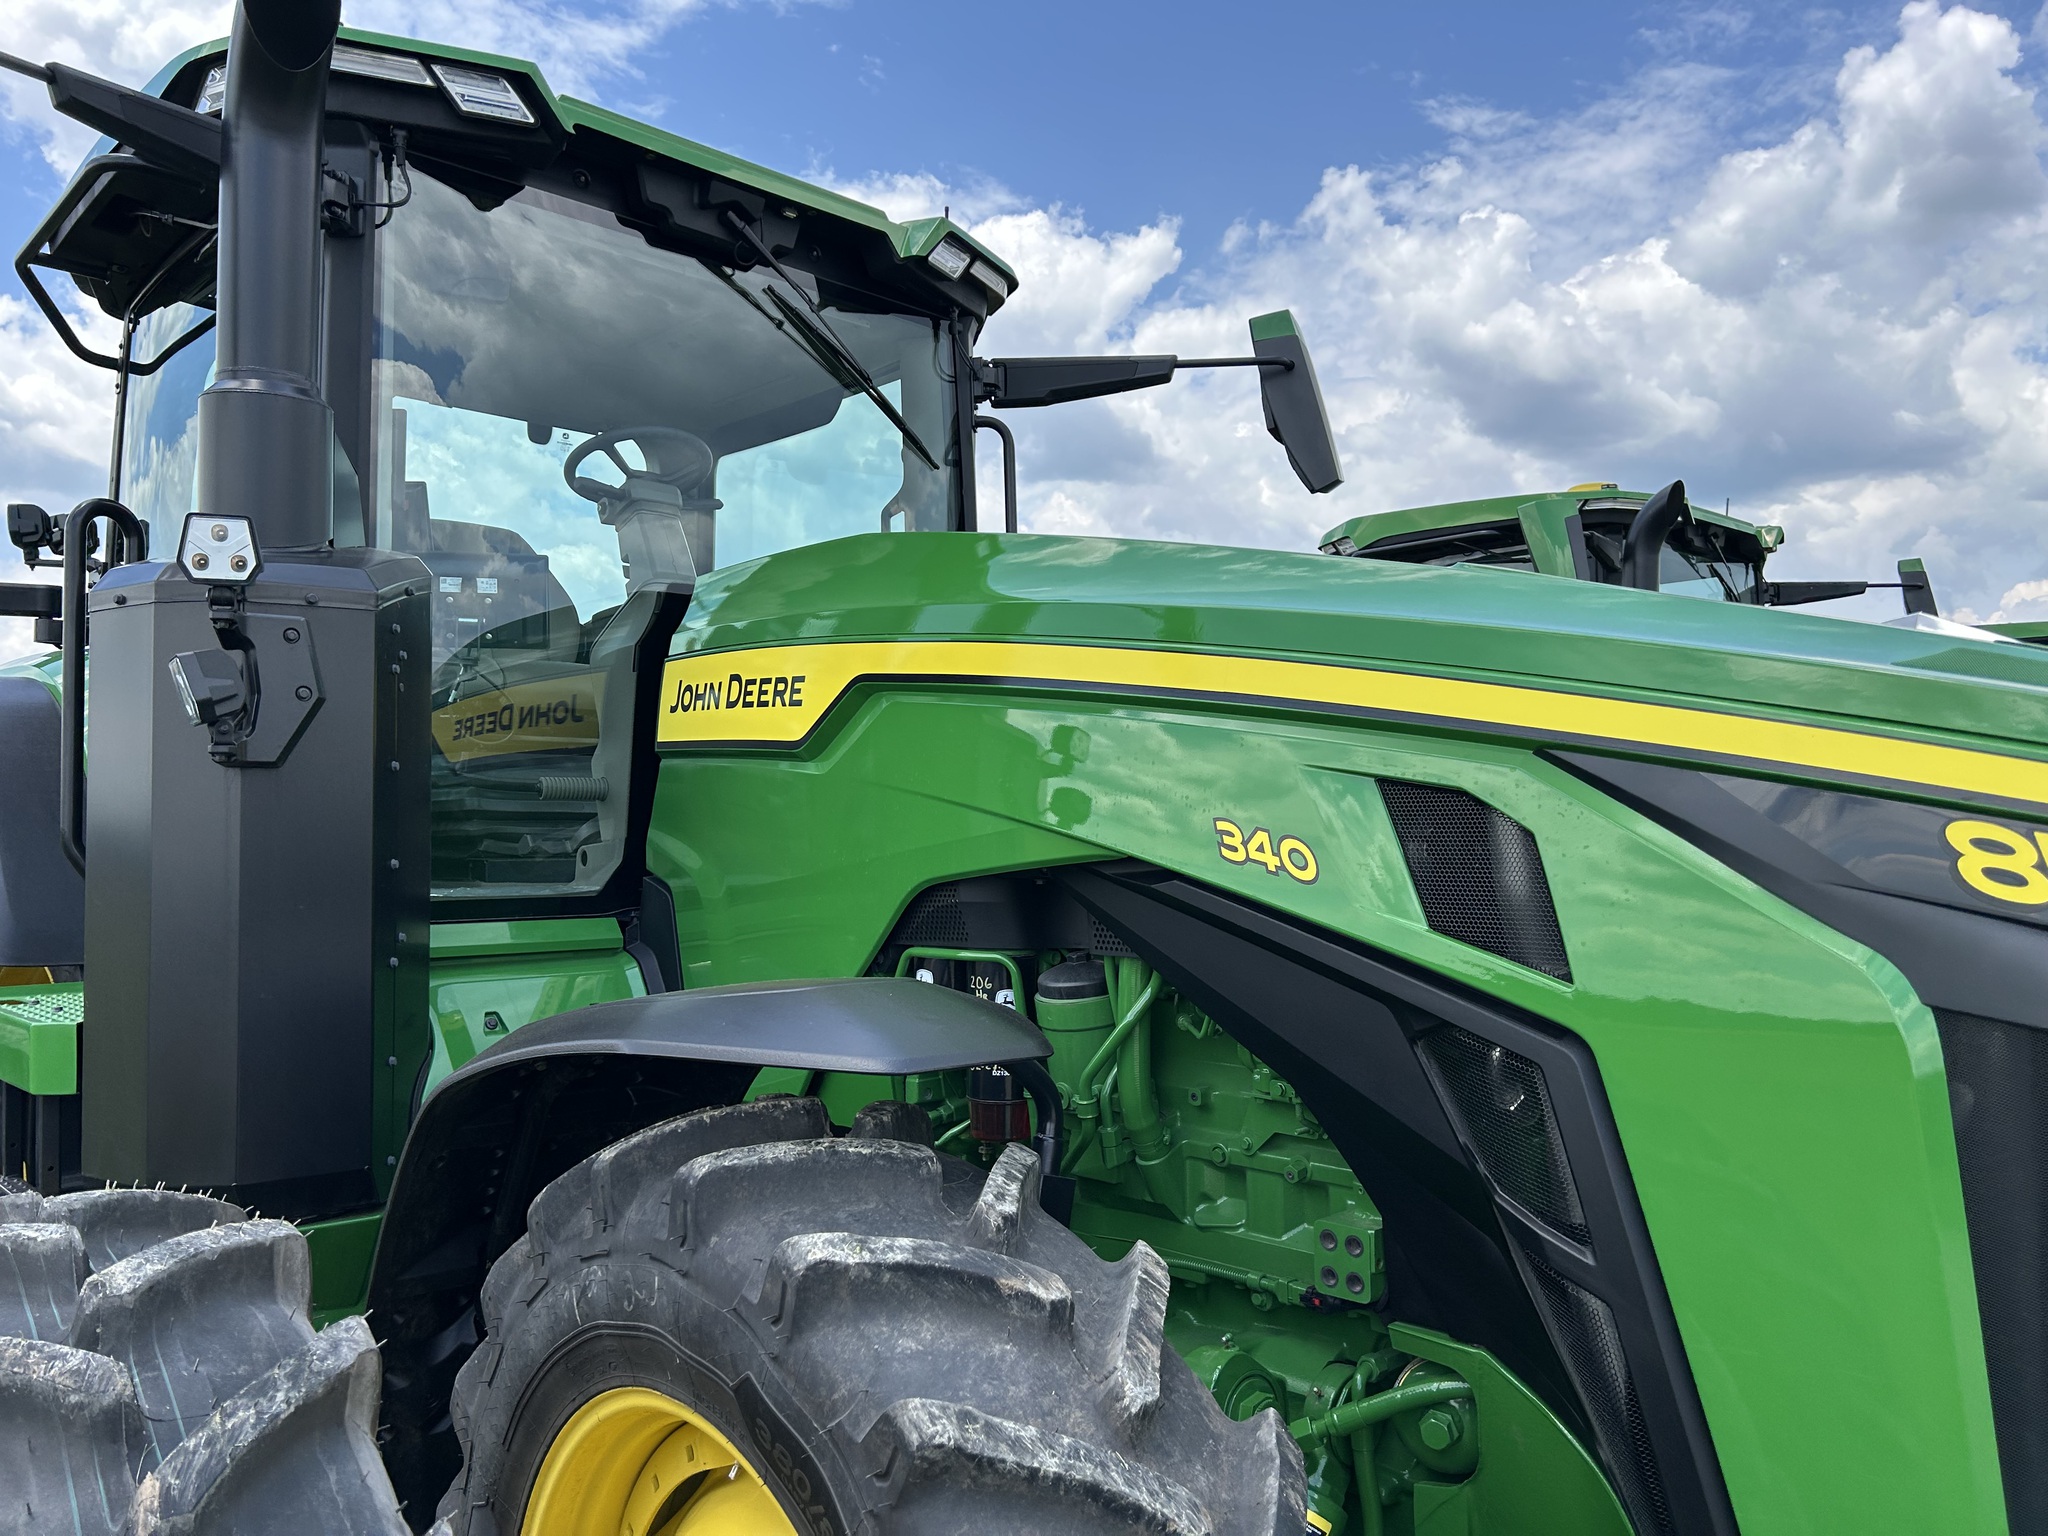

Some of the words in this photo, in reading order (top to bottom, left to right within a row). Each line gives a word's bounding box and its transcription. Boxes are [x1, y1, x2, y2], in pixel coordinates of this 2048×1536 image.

[669, 679, 723, 714] JOHN
[725, 673, 806, 709] DEERE
[1214, 819, 1318, 883] 340
[1944, 818, 2048, 905] 8
[970, 975, 993, 990] 206
